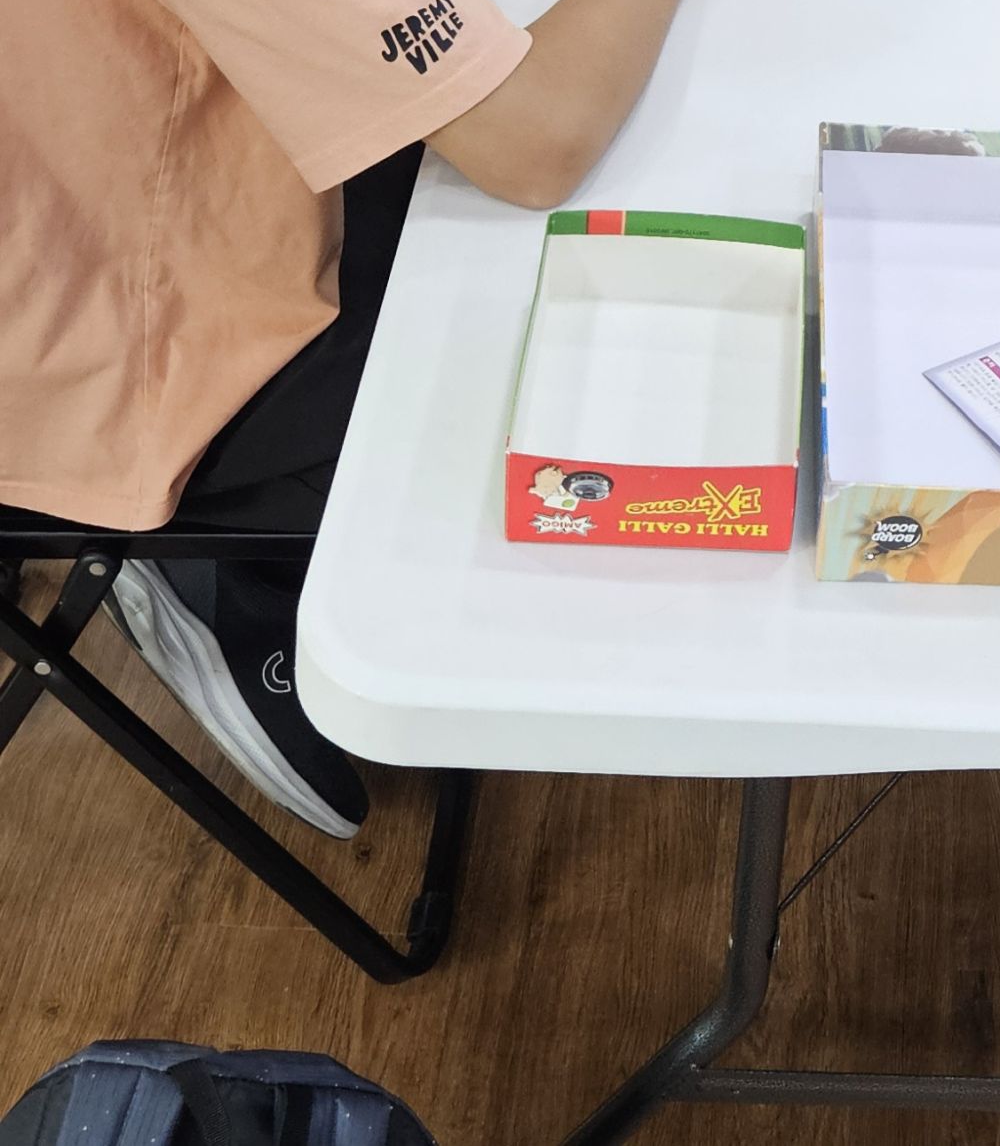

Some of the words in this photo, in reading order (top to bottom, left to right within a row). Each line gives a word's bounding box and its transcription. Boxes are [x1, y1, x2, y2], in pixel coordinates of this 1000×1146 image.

[405, 12, 464, 75] VILLE
[542, 521, 582, 529] AMIGO
[619, 520, 692, 534] GALLI
[697, 522, 769, 537] HALLI
[876, 520, 919, 533] BOOM
[871, 531, 915, 543] BOARD
